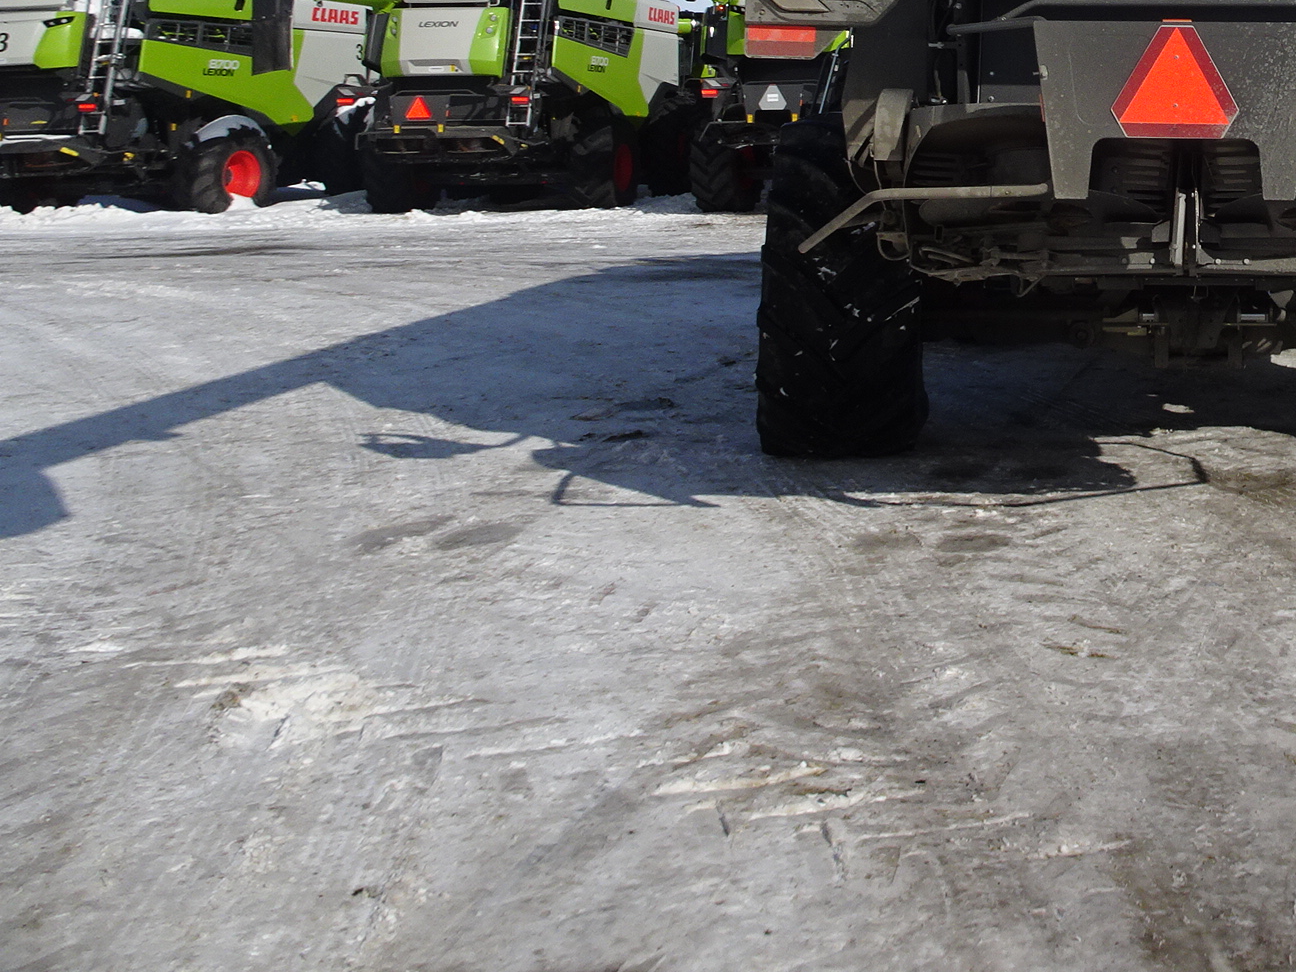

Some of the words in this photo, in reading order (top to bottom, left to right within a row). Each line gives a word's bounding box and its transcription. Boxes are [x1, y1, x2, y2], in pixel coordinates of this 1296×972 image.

[311, 7, 360, 25] CLAAS
[648, 7, 675, 25] CLAAS
[418, 20, 460, 28] LEXION
[203, 68, 235, 77] LEXION
